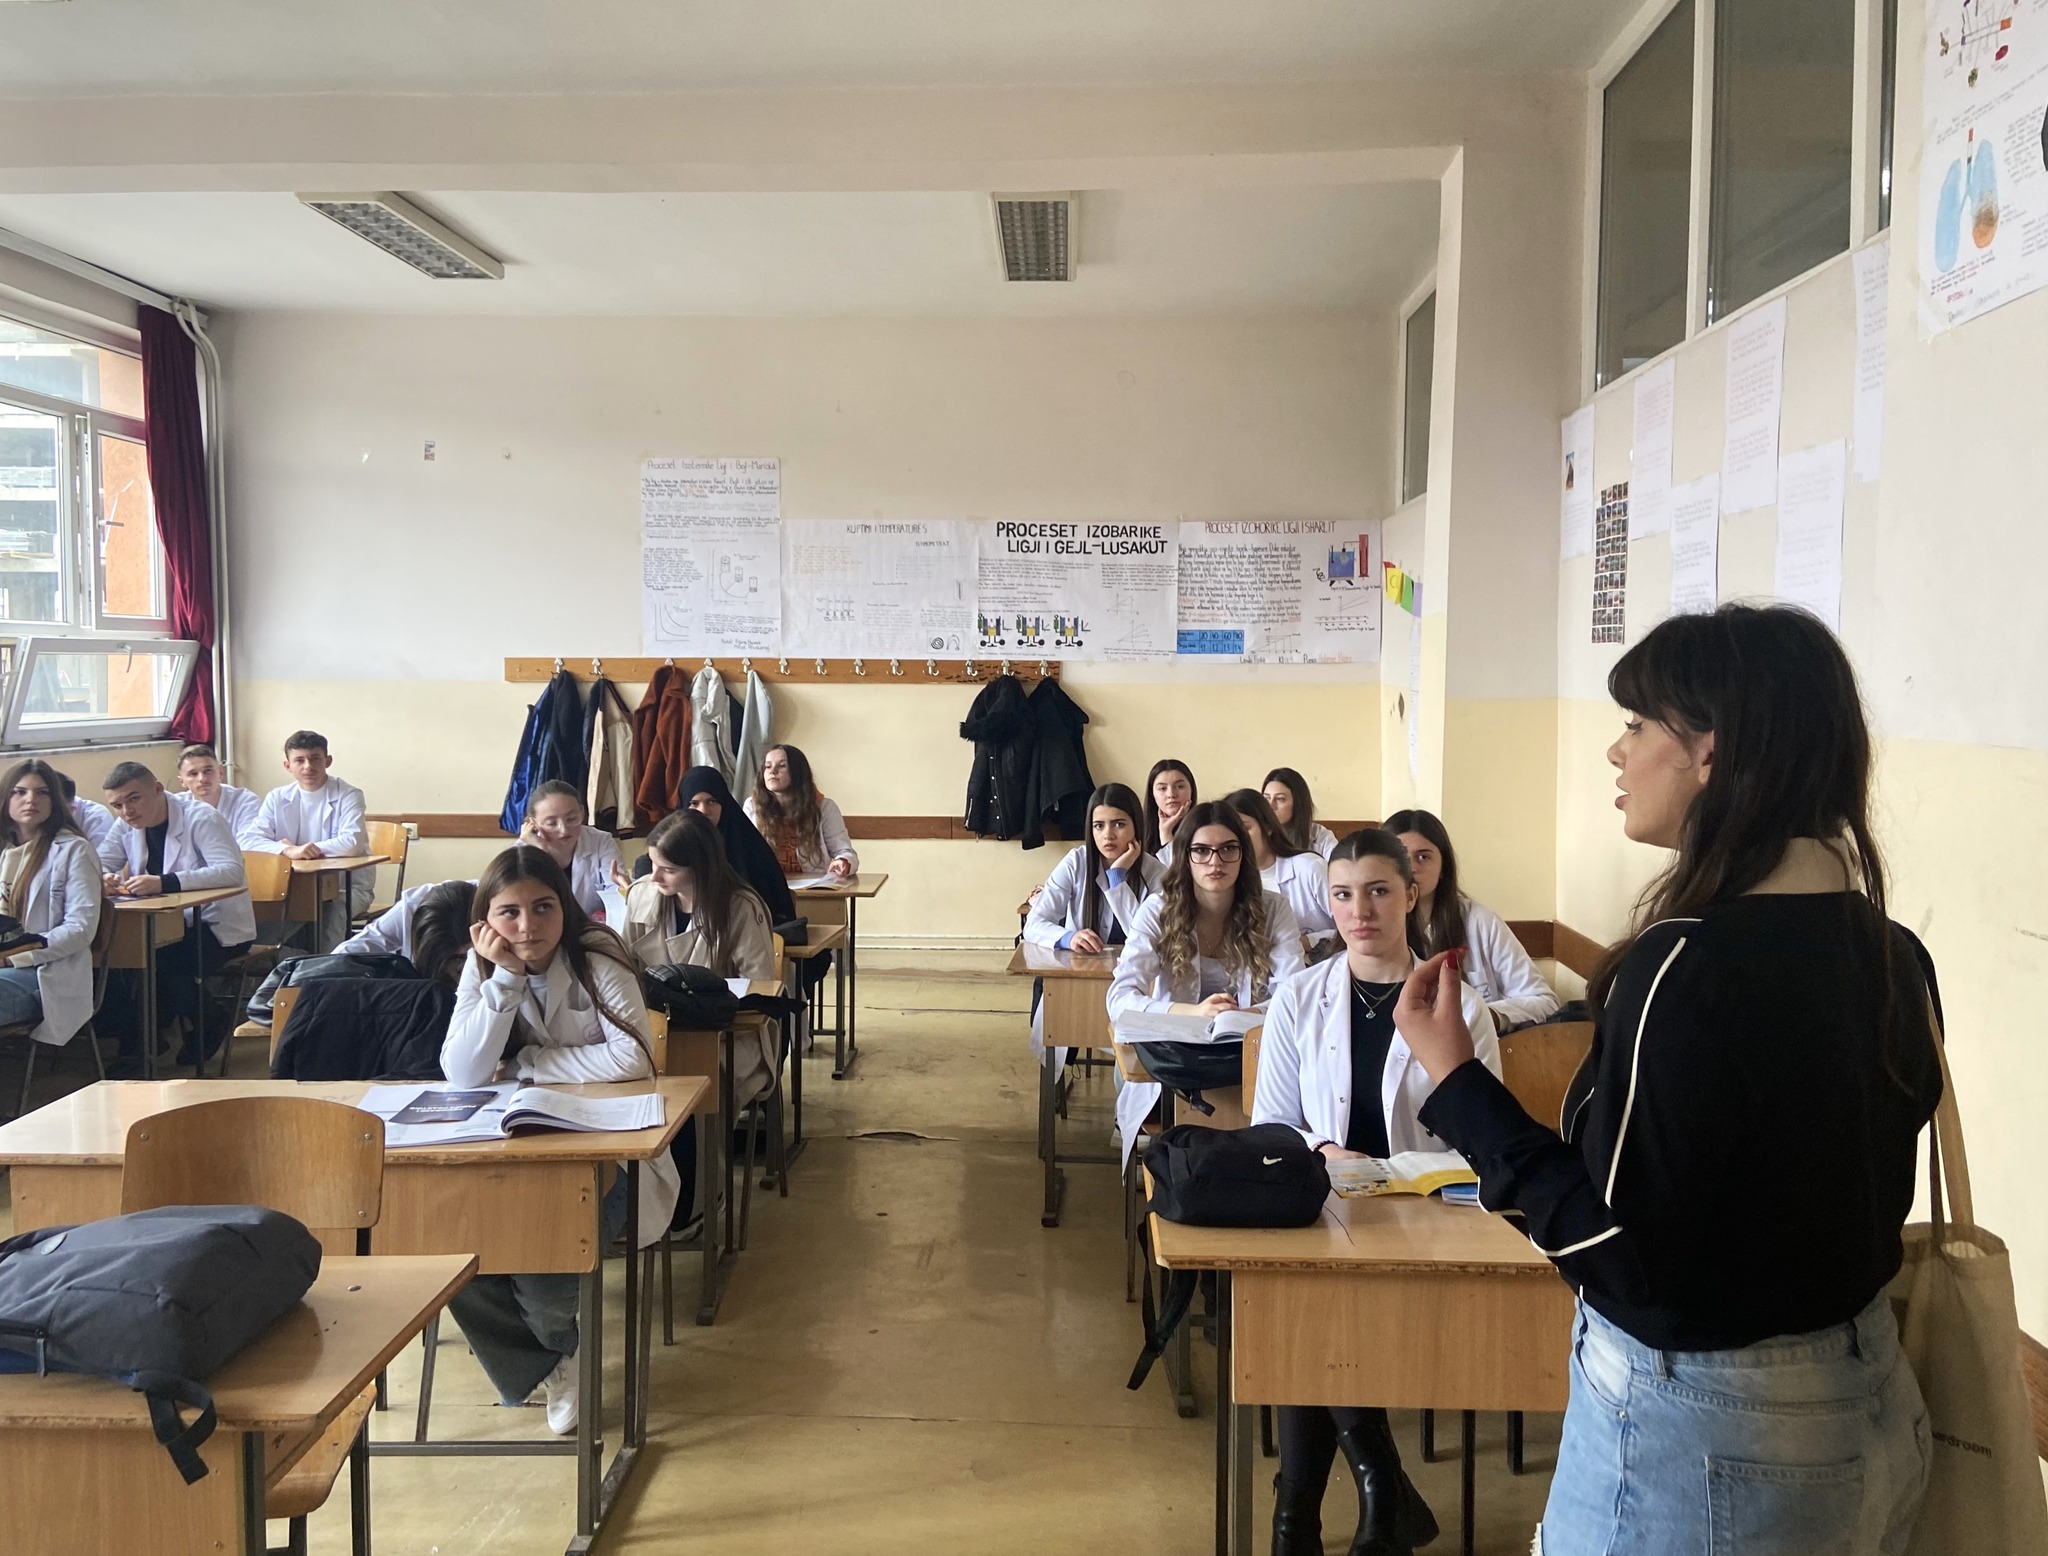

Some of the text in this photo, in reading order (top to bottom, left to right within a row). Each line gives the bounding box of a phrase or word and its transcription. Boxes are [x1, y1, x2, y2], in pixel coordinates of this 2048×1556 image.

[996, 521, 1162, 539] PROCESET IZOBARIKE
[1204, 520, 1239, 534] PROCESET
[1008, 539, 1168, 555] LIGJI I GEJL-LUSAKUT
